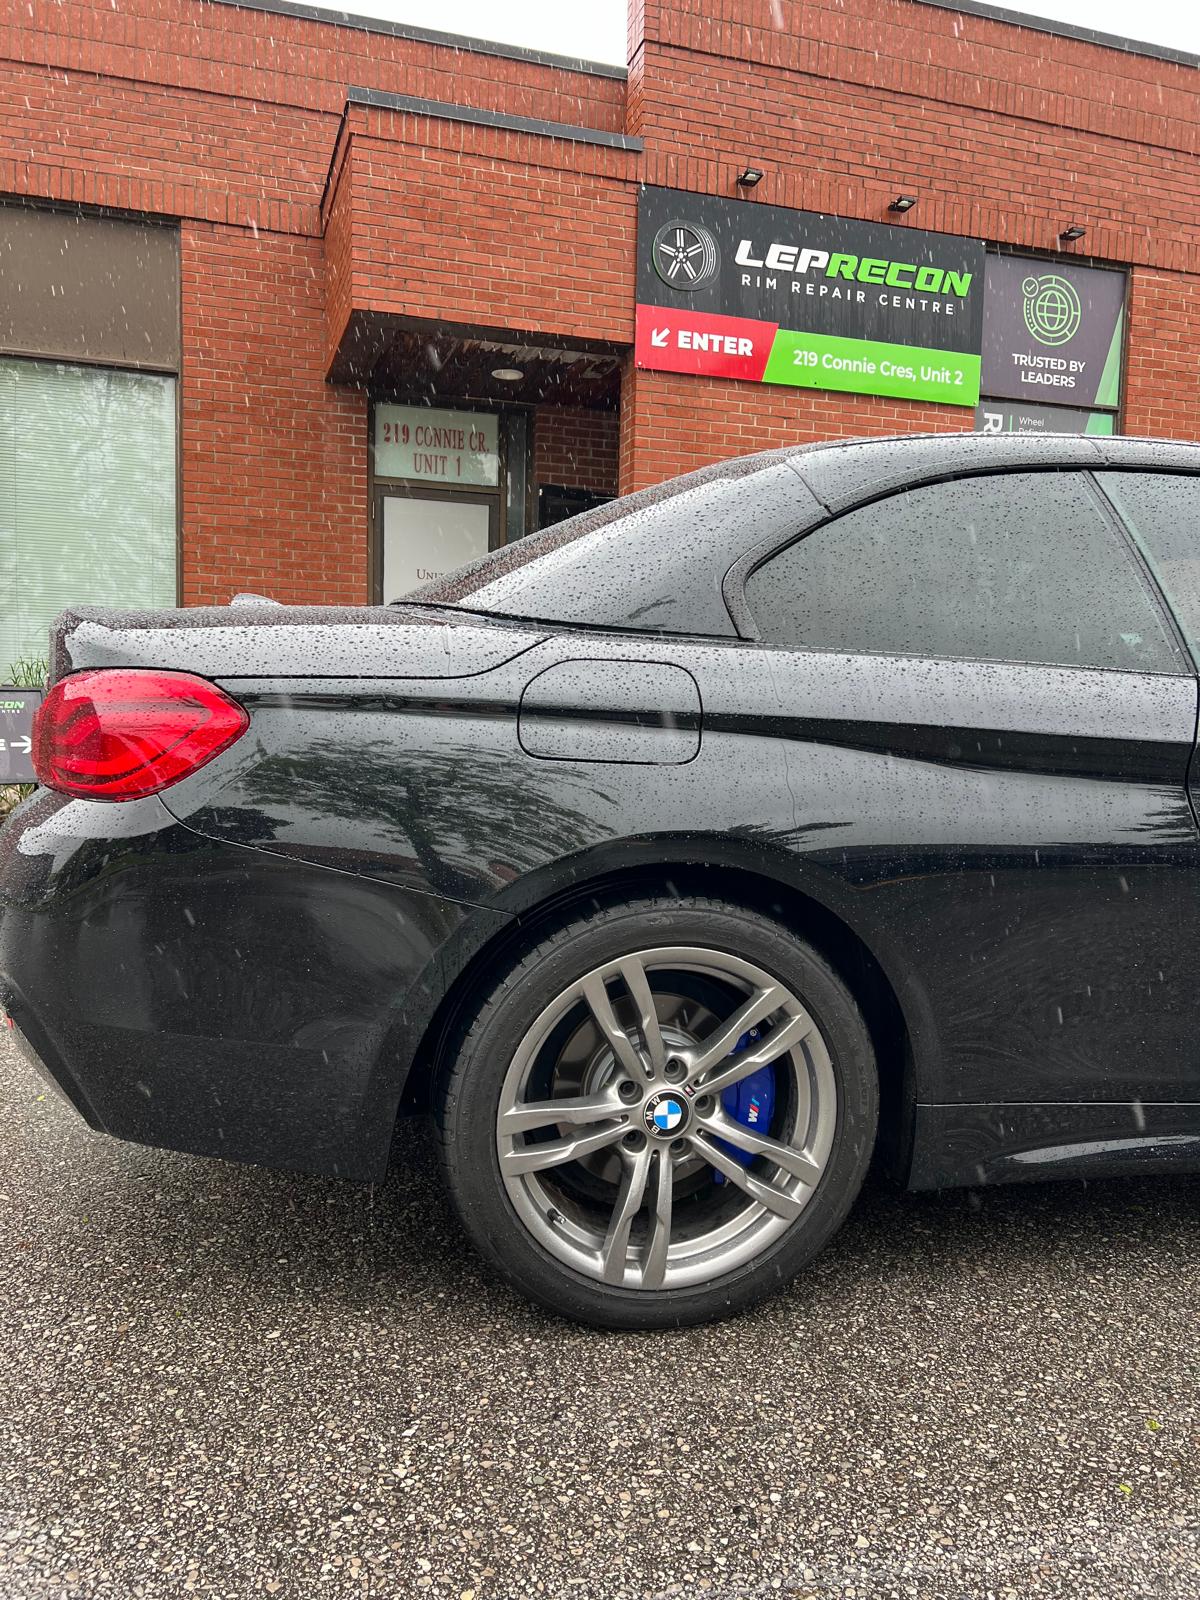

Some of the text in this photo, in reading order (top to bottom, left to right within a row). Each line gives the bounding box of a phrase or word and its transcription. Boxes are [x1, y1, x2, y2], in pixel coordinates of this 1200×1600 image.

[735, 240, 973, 297] LEPRECON
[742, 274, 955, 315] RIM REPAIR CENTRE
[677, 330, 753, 357] ENTER
[793, 349, 963, 385] 219 Connie Cres, Unit 2
[1012, 353, 1086, 373] TRUSTED BY
[1021, 371, 1076, 388] LEADERS
[1019, 416, 1045, 427] Wheel
[383, 422, 490, 452] 219 CONNIE CR.
[413, 453, 462, 477] UNIT 1
[645, 1094, 662, 1135] BMW
